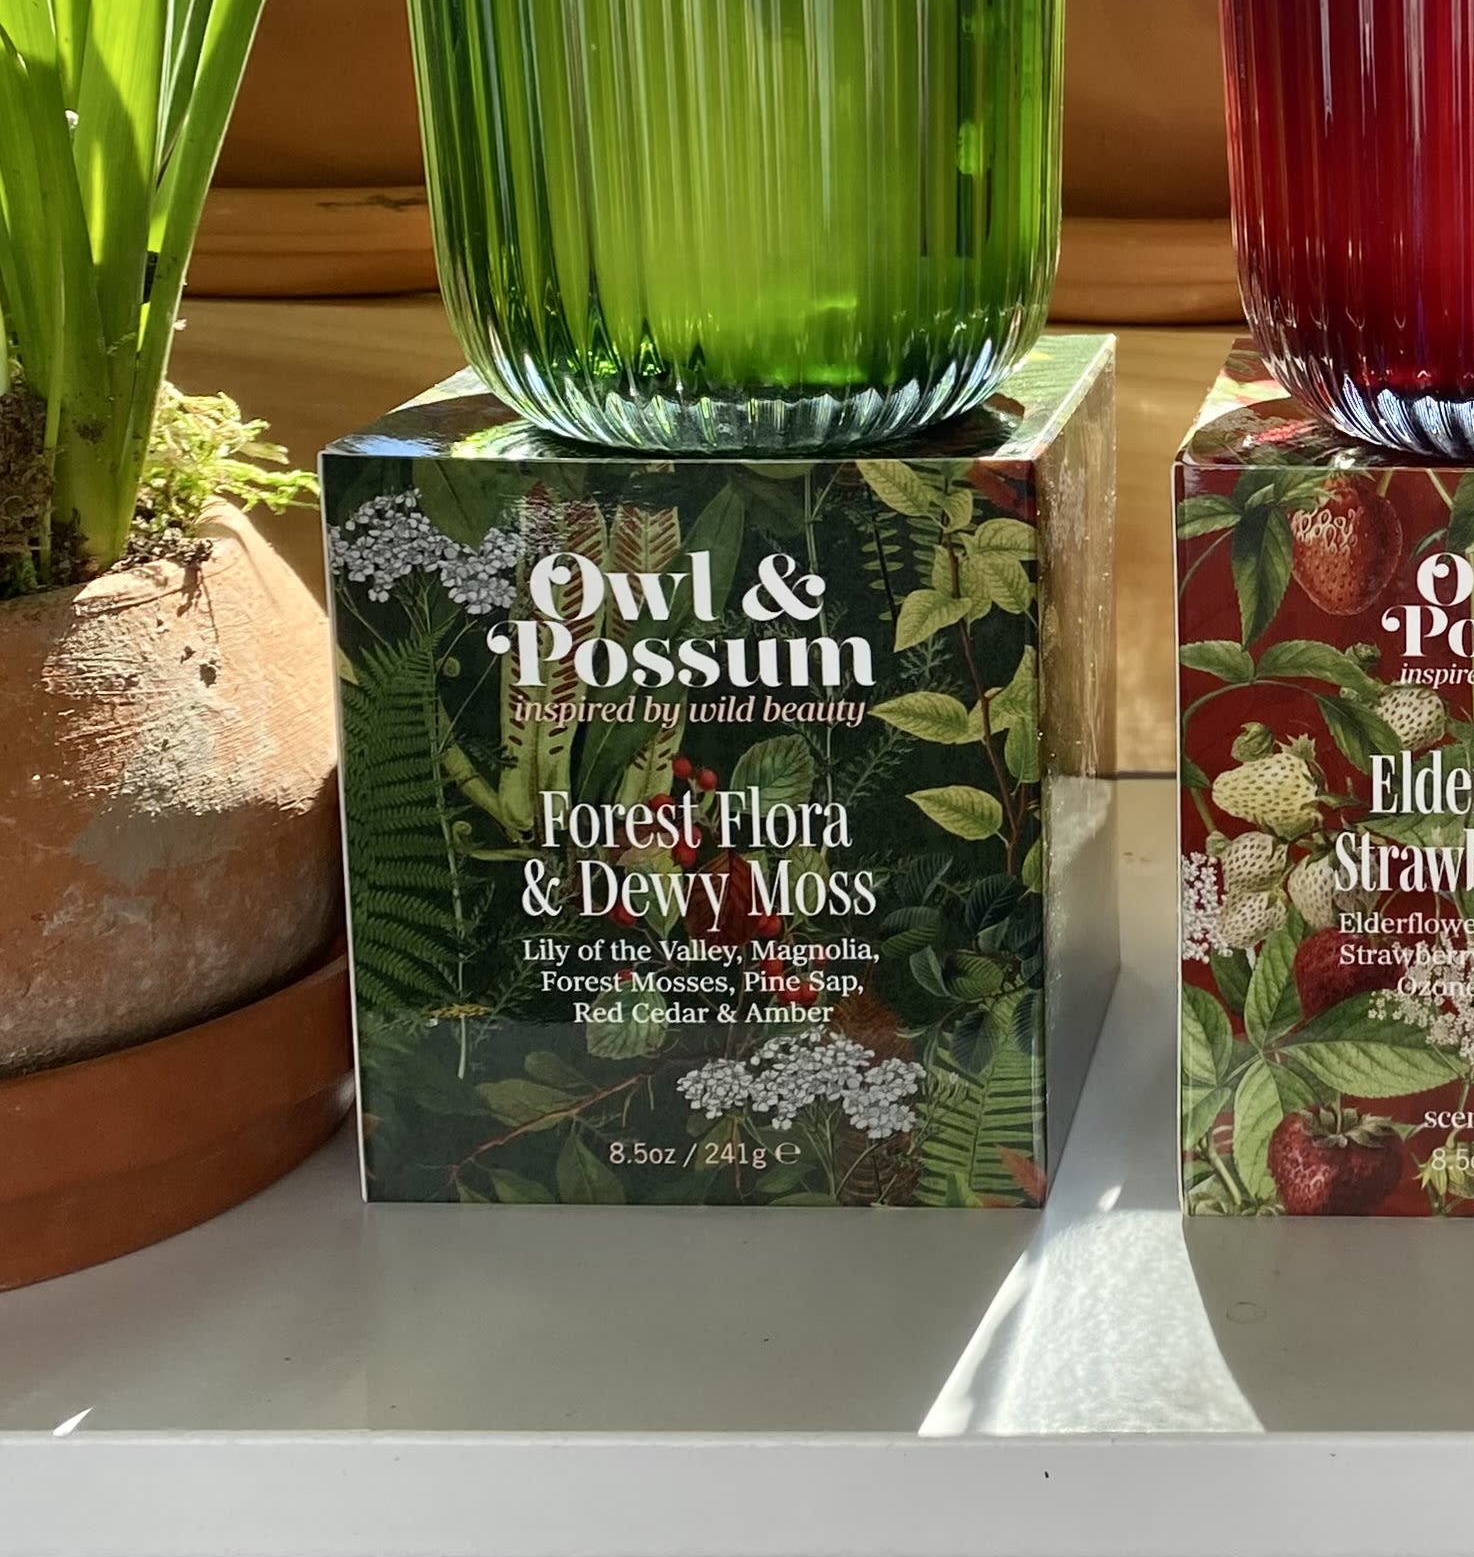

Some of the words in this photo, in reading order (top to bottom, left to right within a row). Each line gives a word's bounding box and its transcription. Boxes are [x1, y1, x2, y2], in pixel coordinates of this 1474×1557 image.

[528, 550, 718, 621] Owl
[742, 553, 826, 621] &
[487, 620, 876, 688] Possum
[514, 696, 635, 726] inspired
[642, 696, 680, 728] by
[689, 696, 754, 723] wild
[763, 696, 866, 728] beauty
[539, 789, 701, 850] Forest
[716, 786, 852, 849] Flora
[521, 857, 562, 917] &
[578, 859, 729, 932] Dewy
[746, 859, 876, 917] Moss
[522, 939, 570, 967] Lily
[577, 938, 607, 963] of
[610, 939, 653, 963] the
[659, 938, 744, 968] Valley,
[751, 937, 880, 967] Magnolia,
[541, 971, 623, 994] Forest
[630, 971, 736, 998] Mosses,
[743, 971, 802, 994] Pine
[809, 971, 864, 998] Sap,
[574, 1001, 625, 1025] Red
[631, 1001, 710, 1025] Cedar
[716, 1002, 738, 1025] &
[745, 1001, 833, 1025] Amber
[609, 1141, 676, 1166] 8.5oz
[682, 1141, 697, 1168] /
[704, 1142, 767, 1170] 241g
